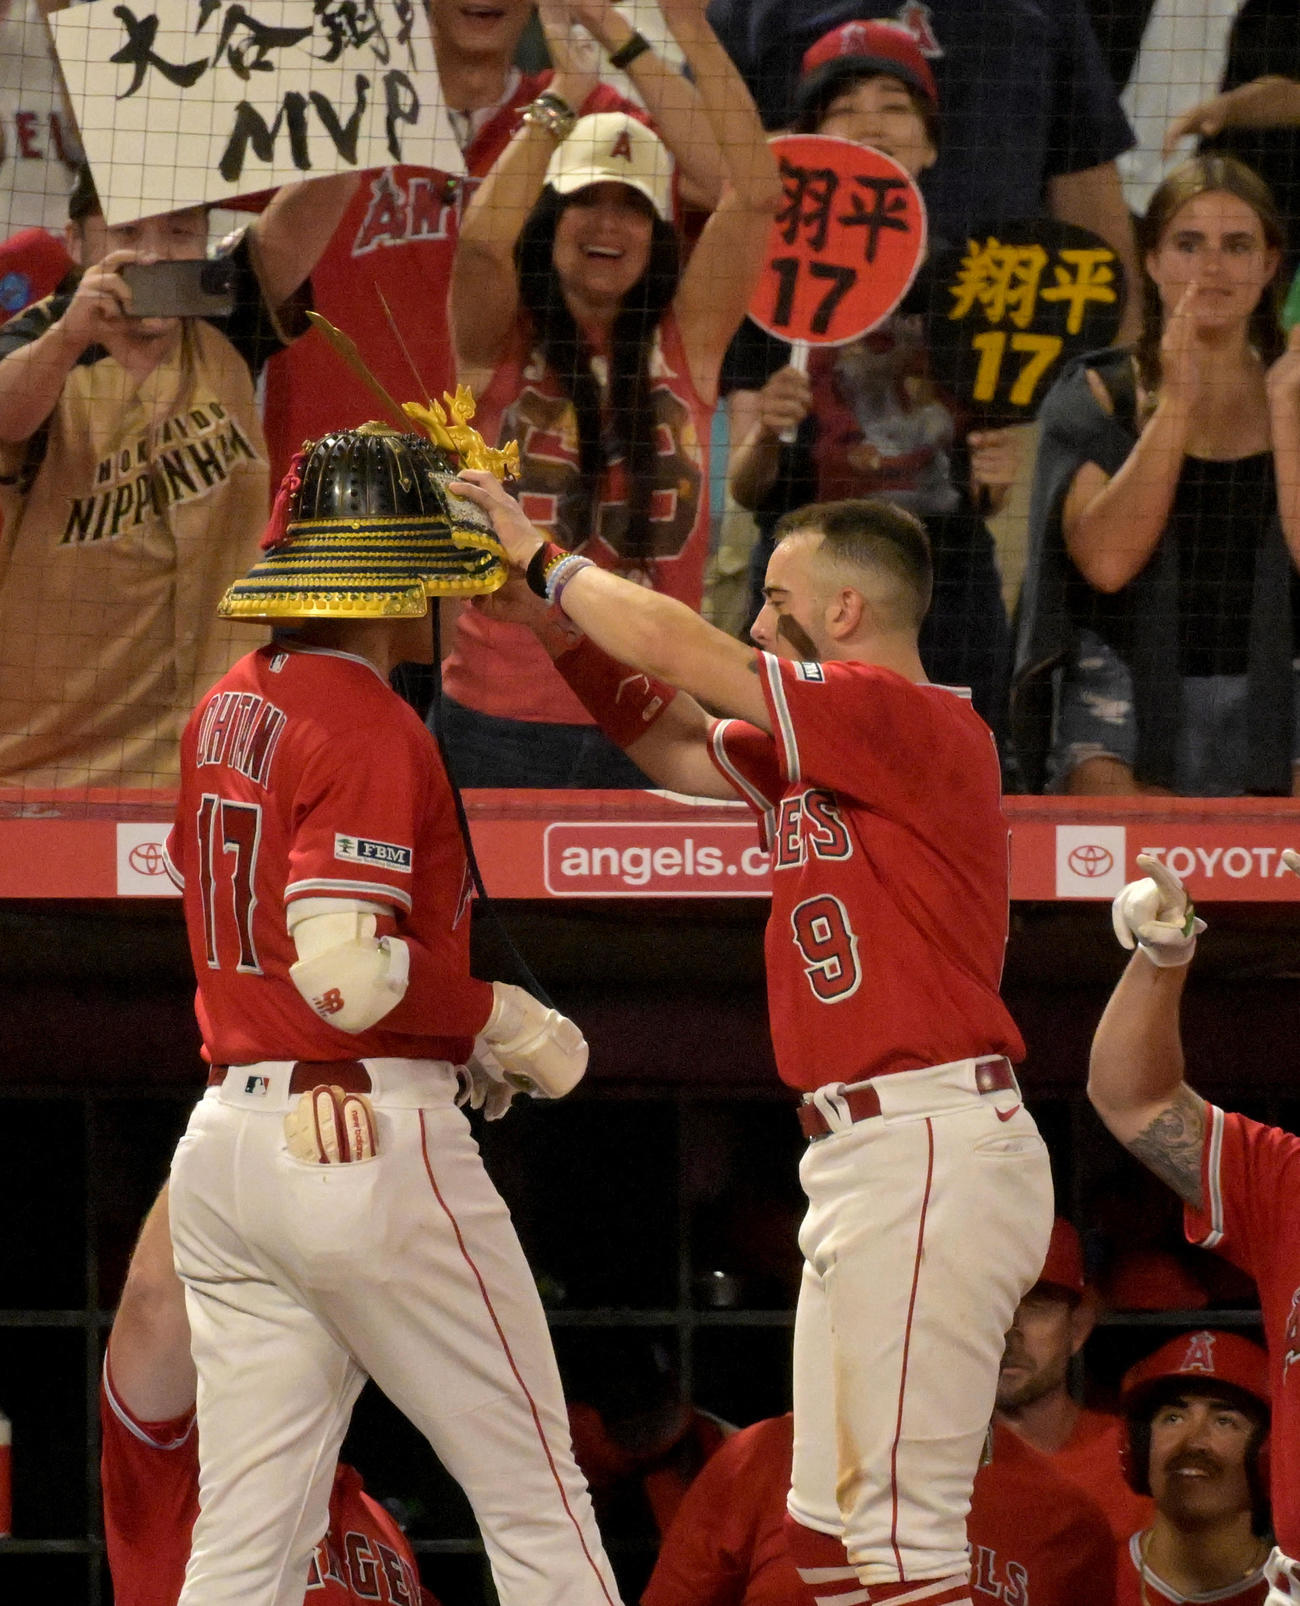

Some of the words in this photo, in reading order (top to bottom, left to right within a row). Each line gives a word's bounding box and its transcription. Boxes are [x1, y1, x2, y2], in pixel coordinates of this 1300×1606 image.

[218, 70, 420, 183] MVP
[610, 127, 632, 162] A
[771, 258, 858, 336] 17
[948, 236, 1117, 335] 翔平
[972, 331, 1063, 406] 17
[196, 691, 287, 791] OHTANI
[197, 792, 264, 975] 17
[363, 843, 406, 863] FBM
[792, 894, 862, 1005] 9
[1180, 1331, 1216, 1372] A
[967, 1541, 1029, 1606] LS
